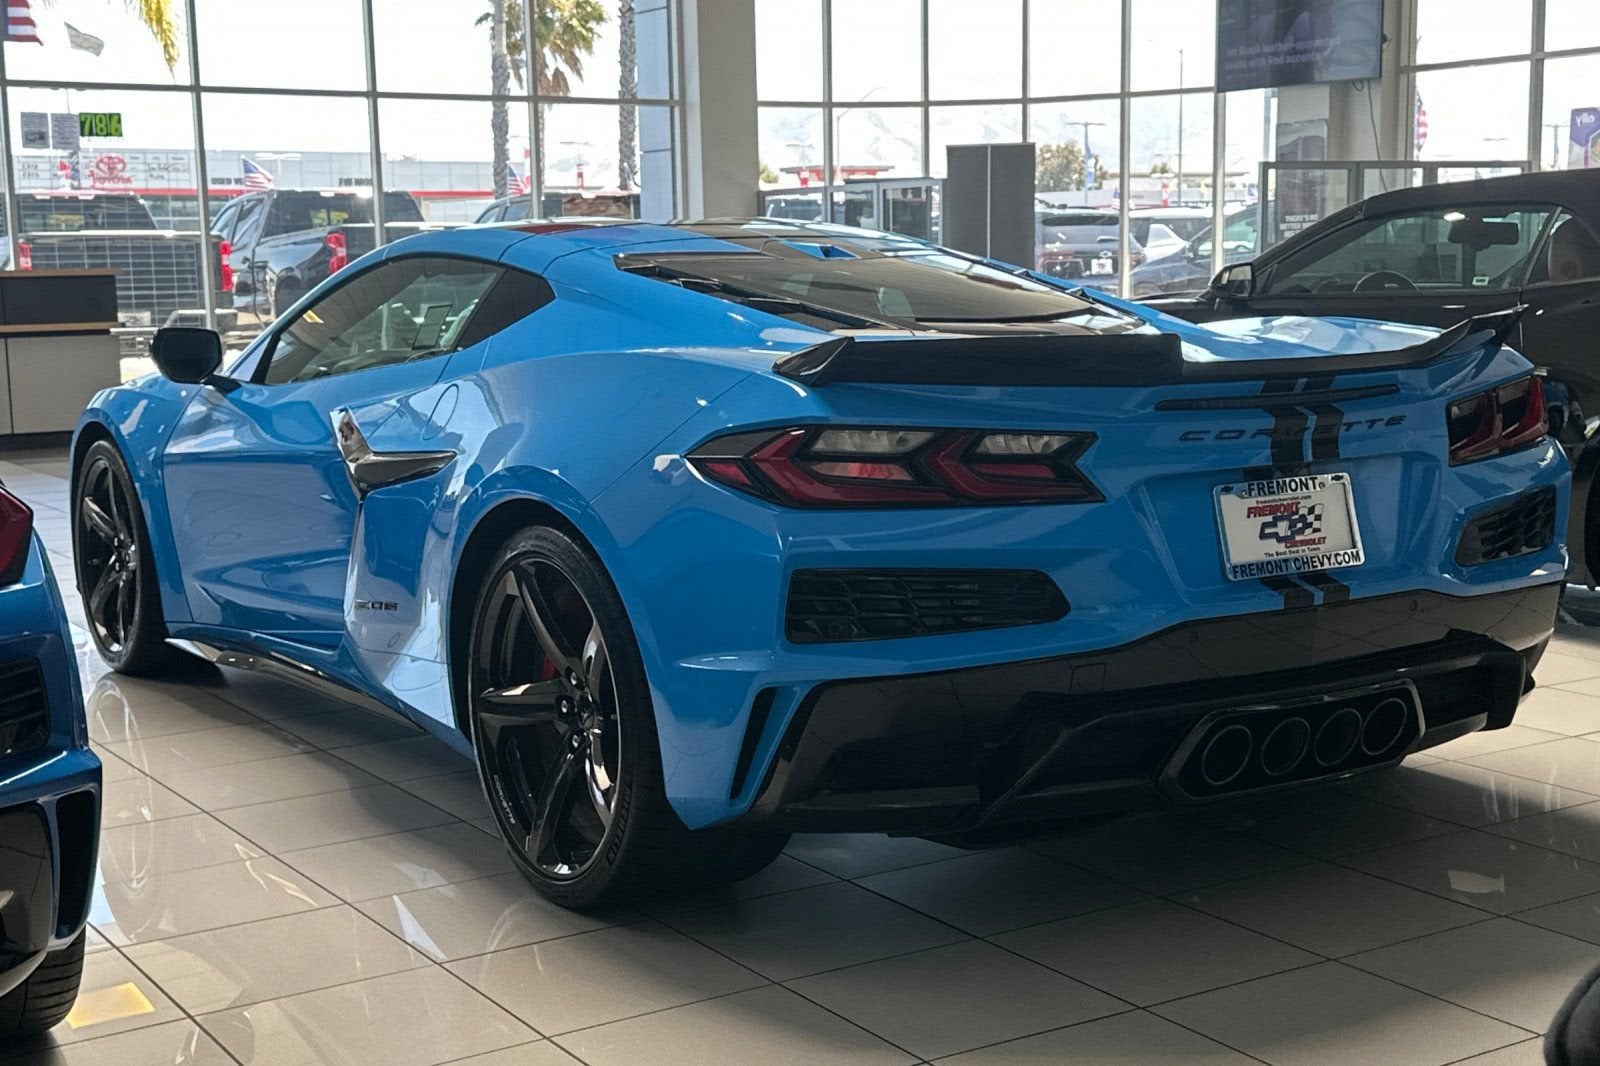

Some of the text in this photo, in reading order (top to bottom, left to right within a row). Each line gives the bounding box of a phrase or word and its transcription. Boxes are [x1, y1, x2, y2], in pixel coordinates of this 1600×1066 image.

[1179, 415, 1407, 441] CORVETTE
[1248, 477, 1317, 496] FREMONT
[1246, 501, 1300, 518] FREMONT
[1285, 537, 1327, 549] CHEVROLET
[1232, 550, 1361, 579] FREMONT CHEVY.COM
